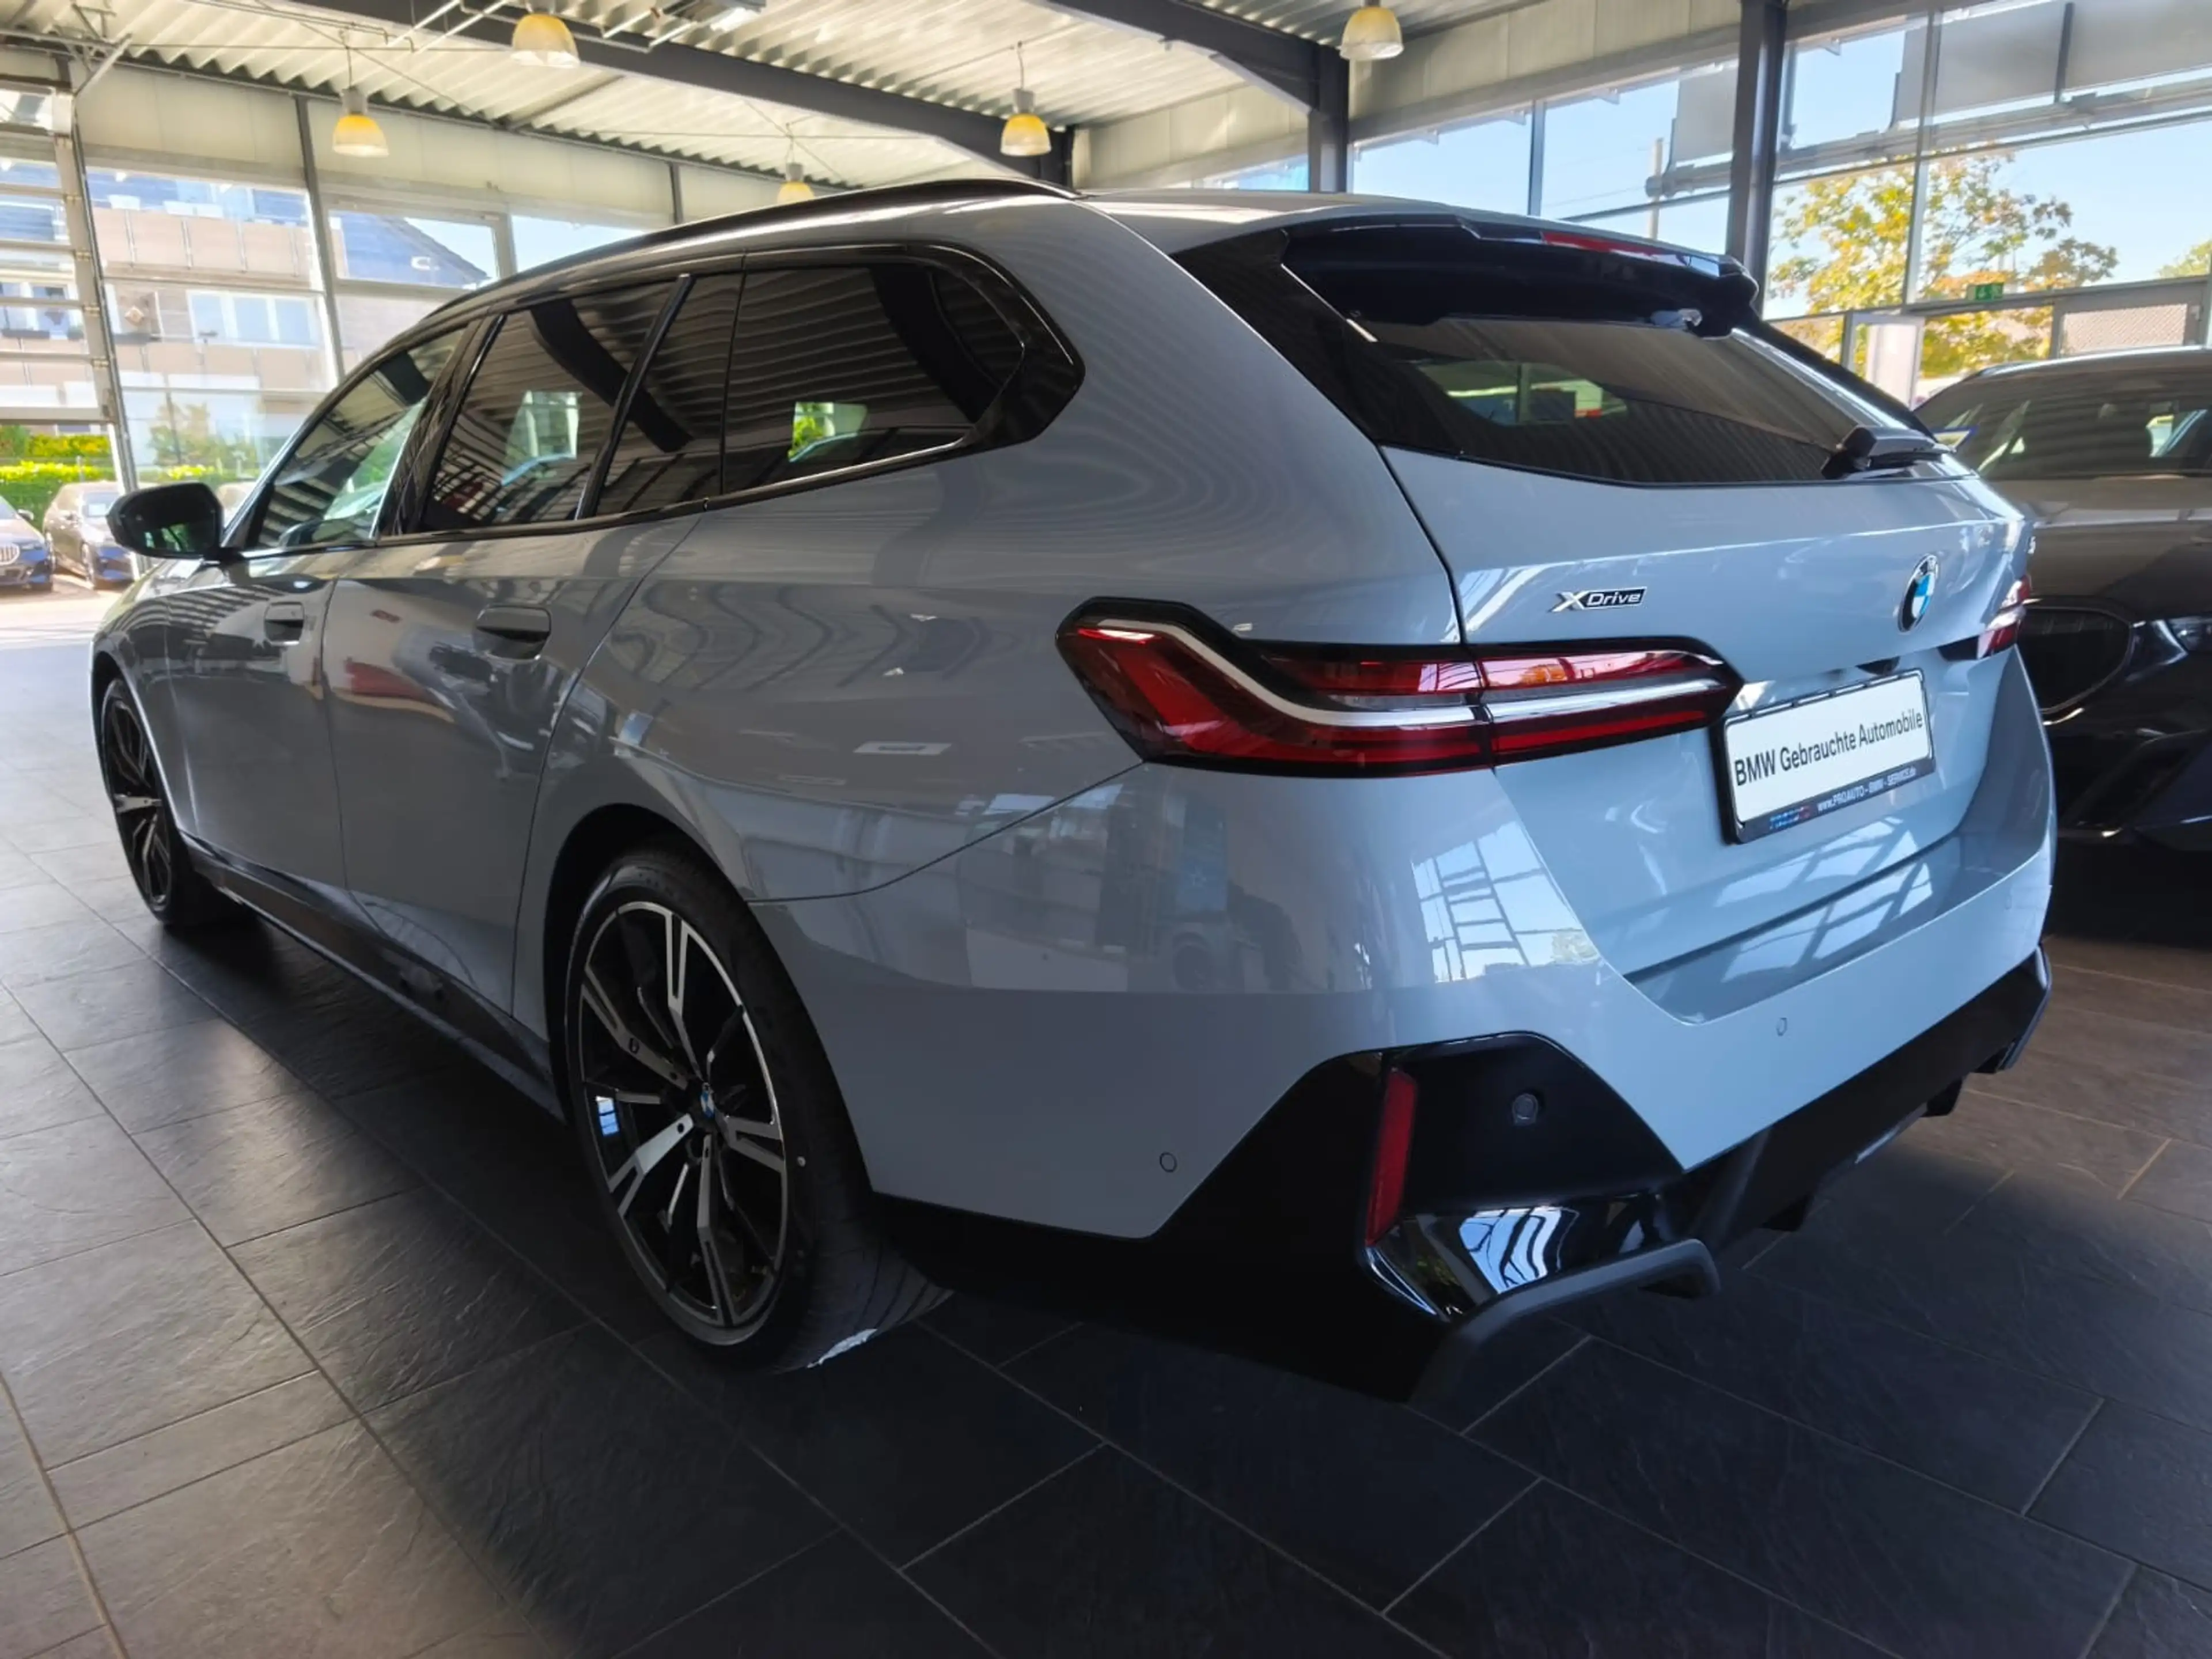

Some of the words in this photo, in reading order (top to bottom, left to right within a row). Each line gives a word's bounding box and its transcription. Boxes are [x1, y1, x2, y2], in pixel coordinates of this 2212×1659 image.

[1735, 749, 1775, 786] BMW
[1780, 732, 1856, 771] Gebrauchte
[1859, 709, 1922, 748] Automobile
